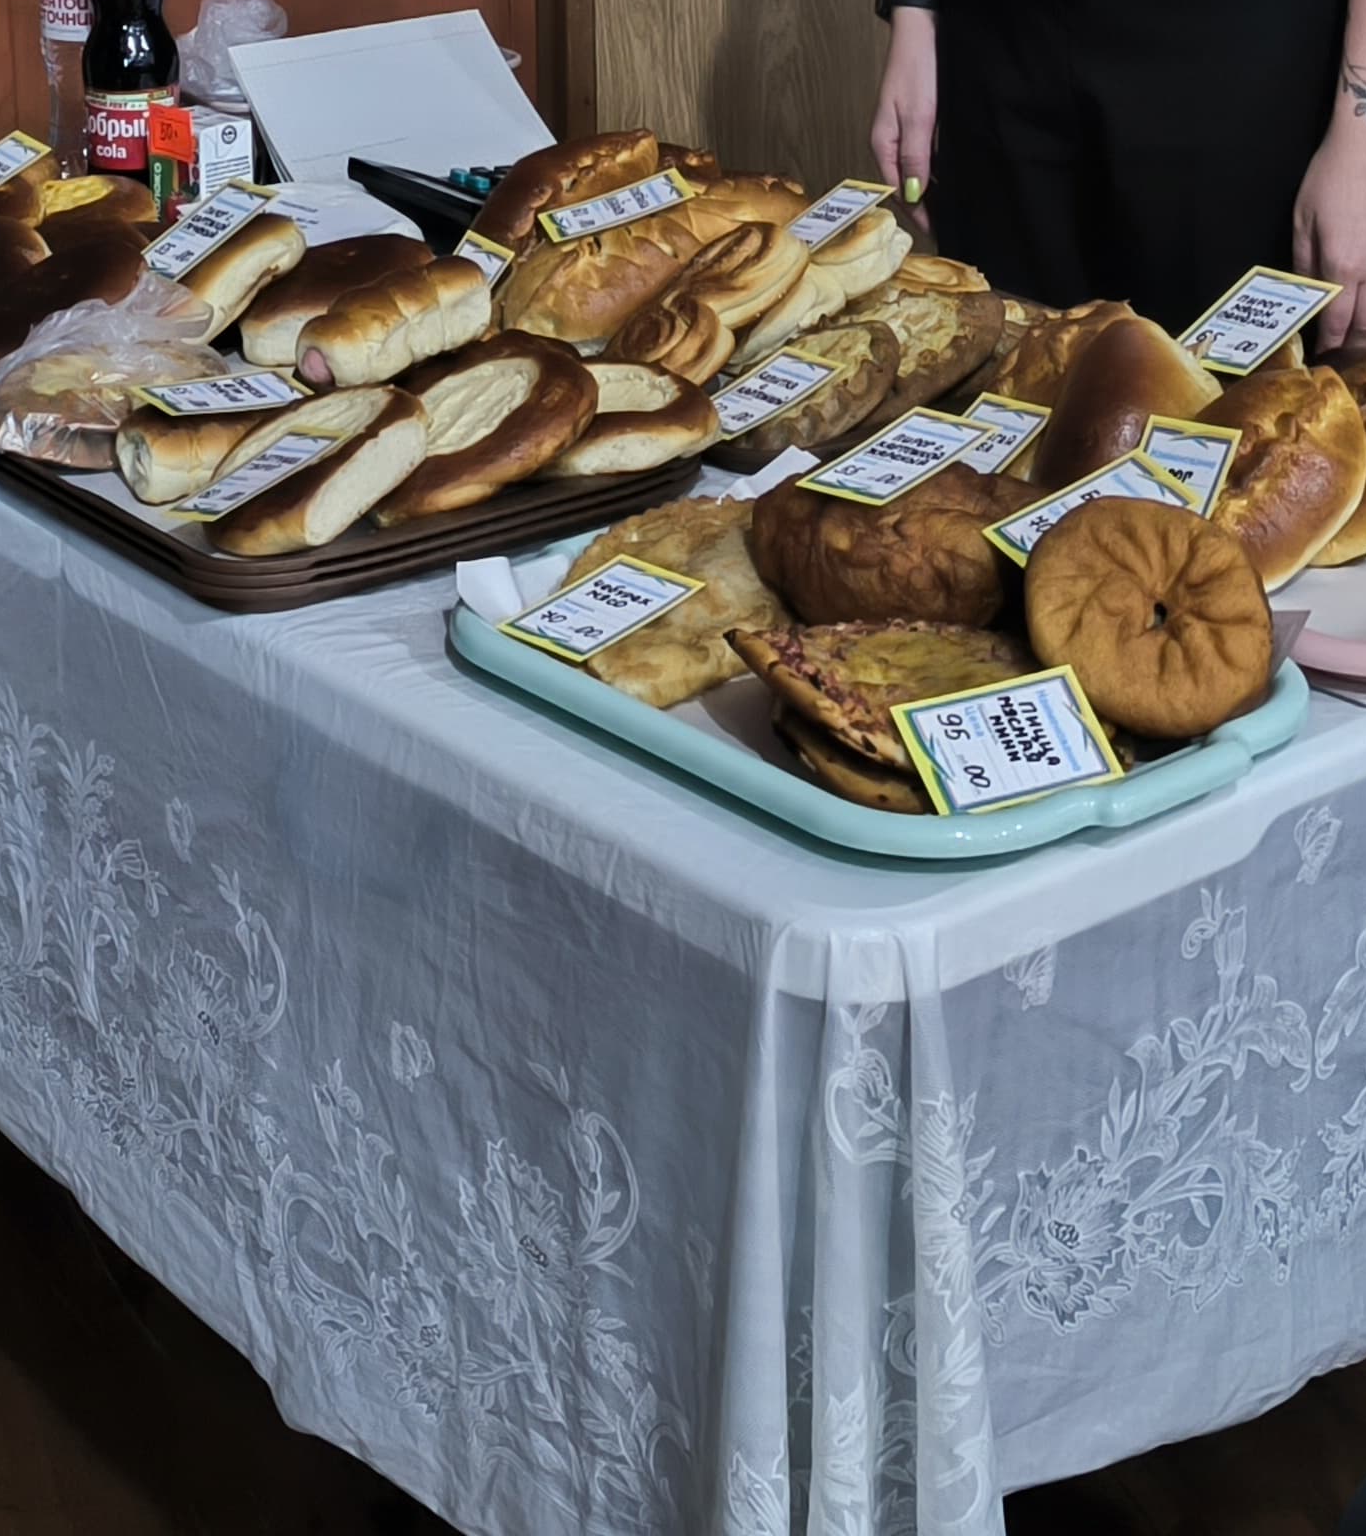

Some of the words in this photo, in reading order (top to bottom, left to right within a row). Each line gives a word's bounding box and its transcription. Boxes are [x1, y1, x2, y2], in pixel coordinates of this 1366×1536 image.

[96, 144, 127, 159] cola
[1233, 340, 1258, 352] 00
[833, 464, 866, 476] 55
[936, 713, 971, 740] 95
[962, 764, 991, 788] 00
[988, 714, 1021, 762] МИНИ
[997, 695, 1040, 762] МЯСНАЯ
[1018, 701, 1060, 766] ПИЦЦА
